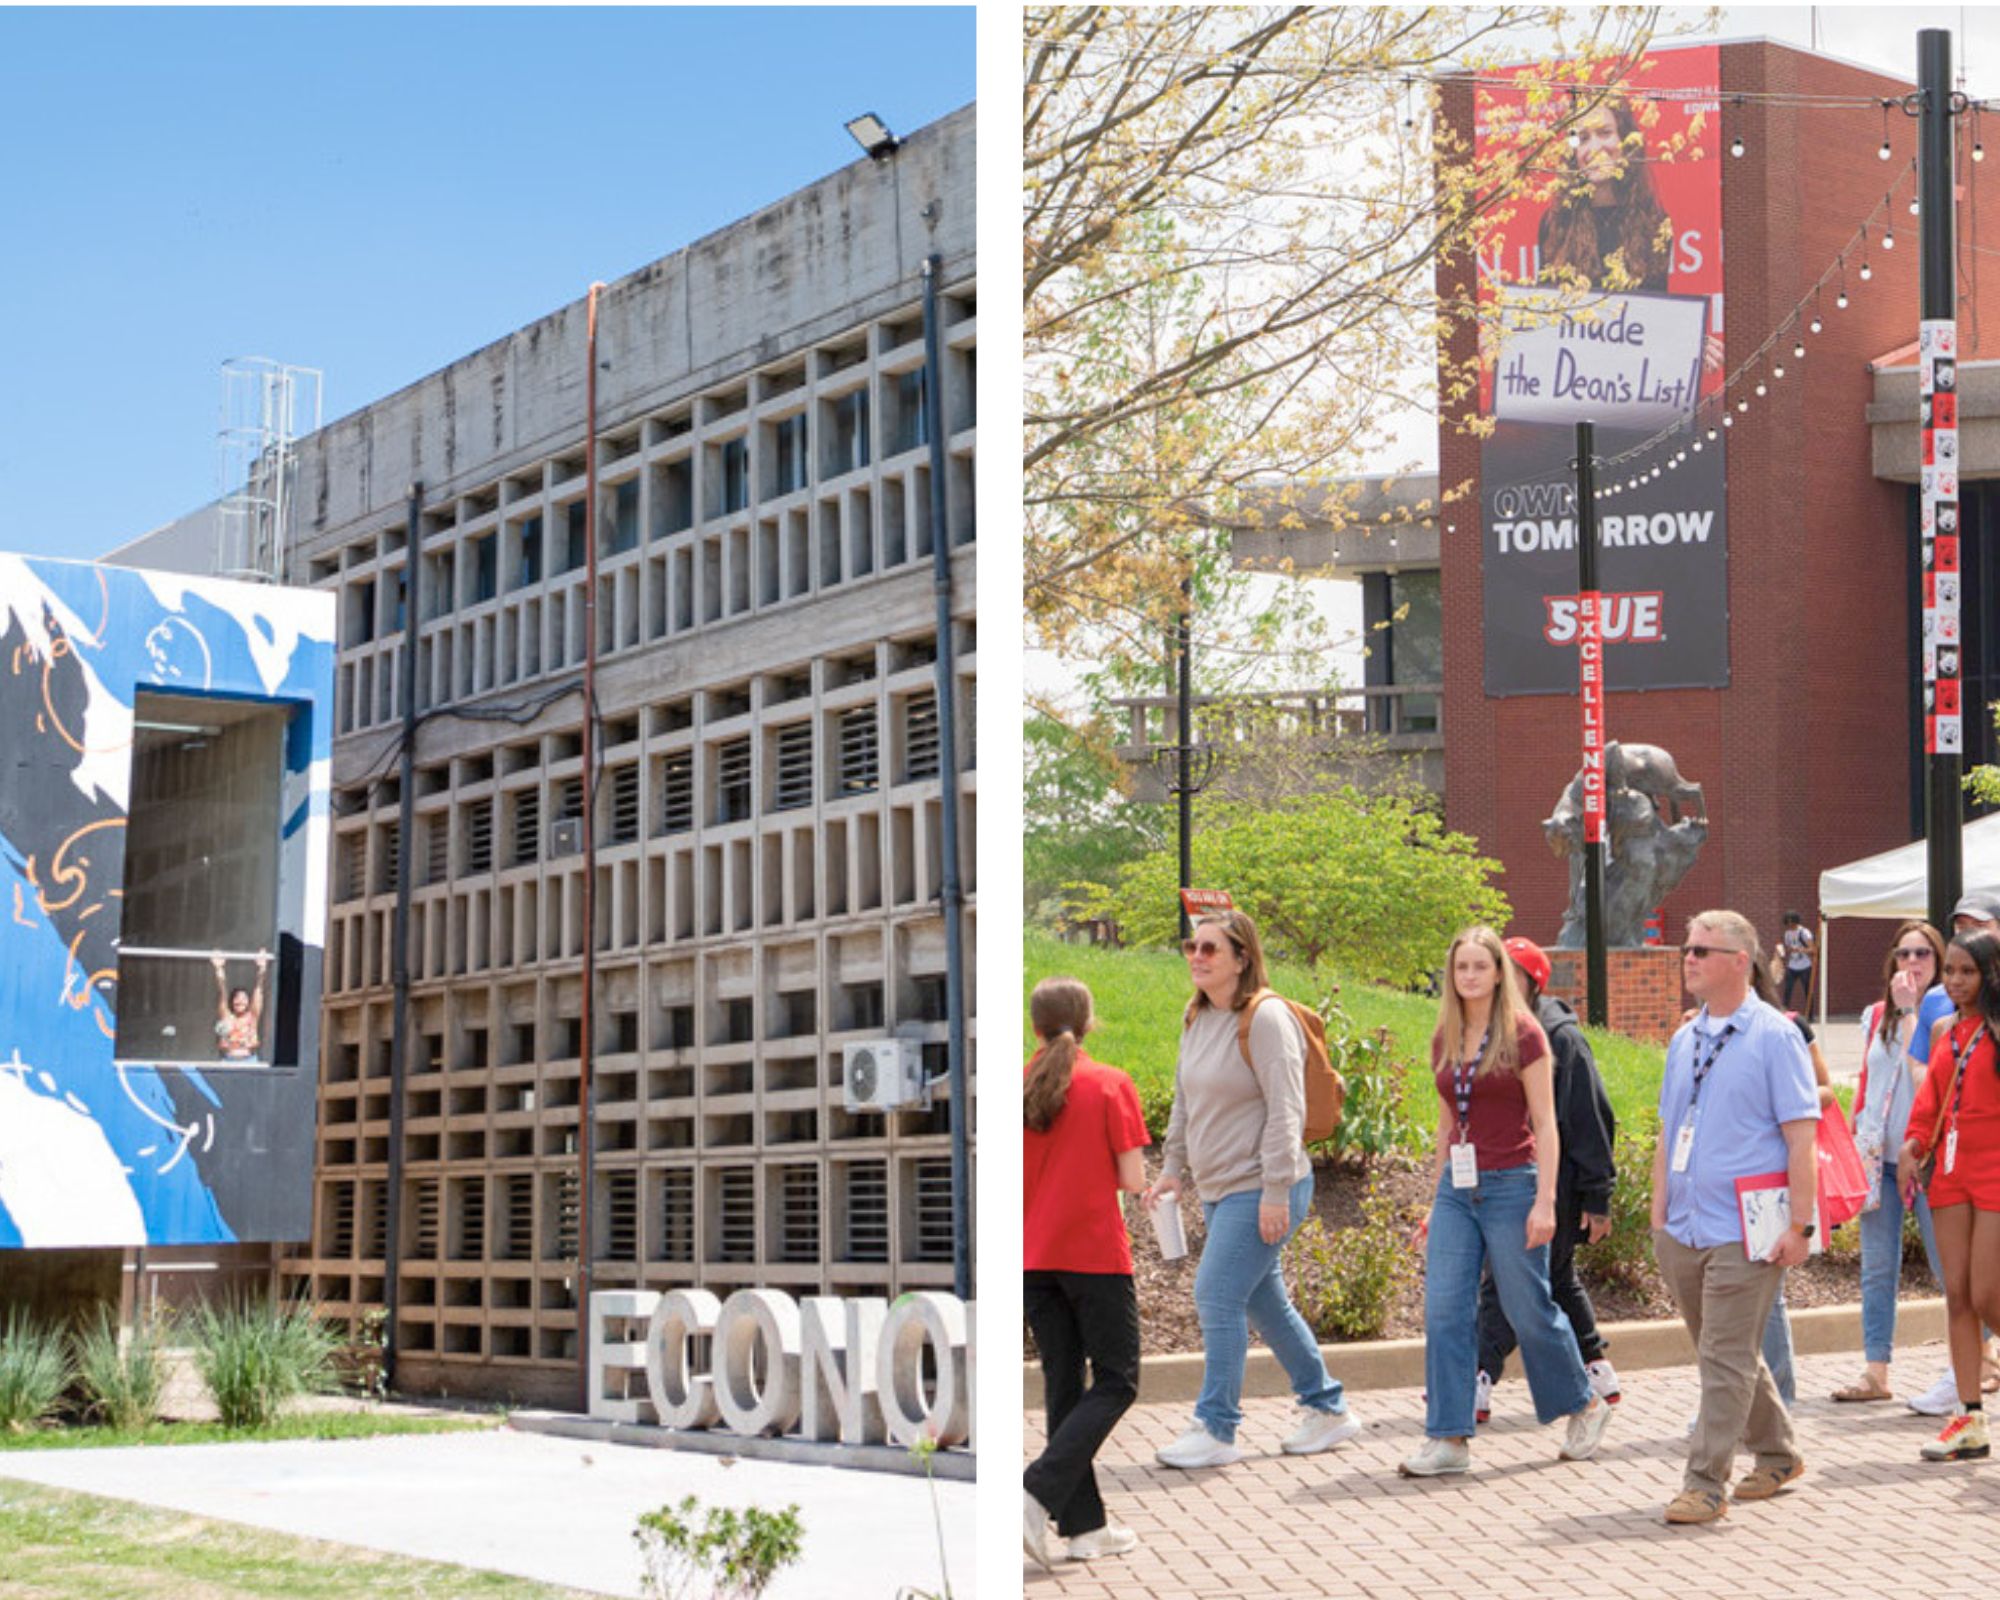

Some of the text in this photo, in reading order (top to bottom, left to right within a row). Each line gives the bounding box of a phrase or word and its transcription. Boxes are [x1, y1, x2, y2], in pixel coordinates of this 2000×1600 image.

[1503, 347, 1699, 413] the Dean's List!
[1493, 510, 1714, 553] TOMRROW
[1547, 594, 1661, 642] SUE
[1580, 599, 1601, 813] EXCELLENCE
